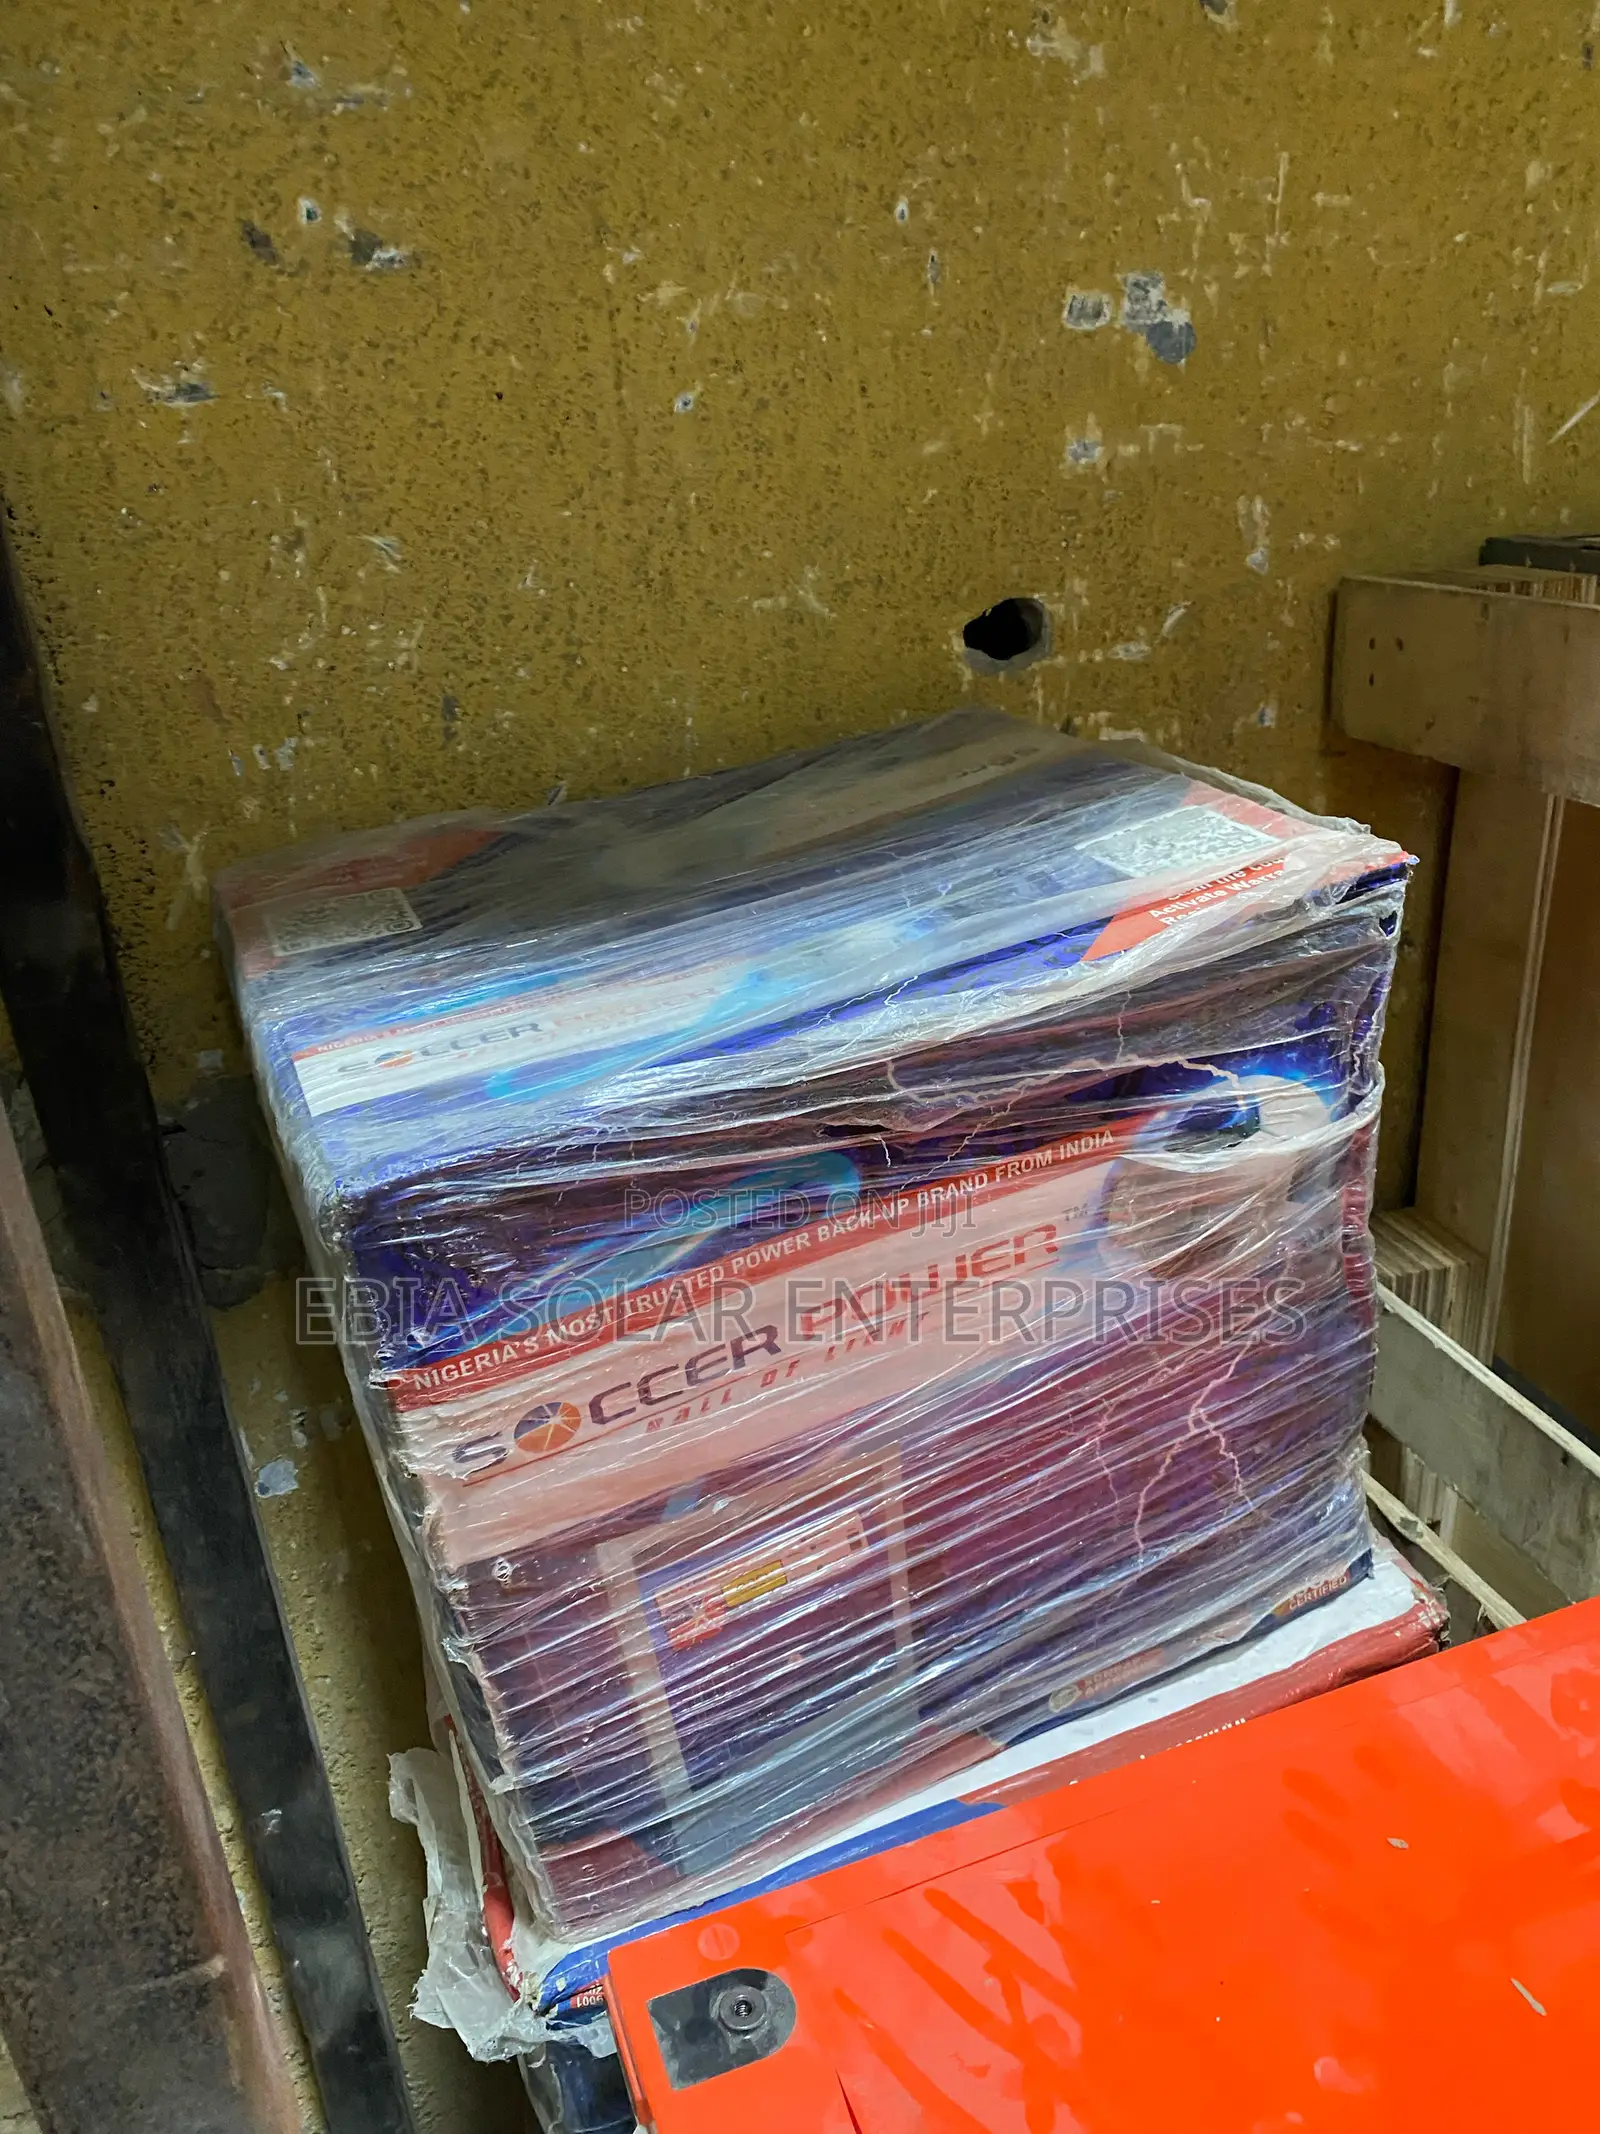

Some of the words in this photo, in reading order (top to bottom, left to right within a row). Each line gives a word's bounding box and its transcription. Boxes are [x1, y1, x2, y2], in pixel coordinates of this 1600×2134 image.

[1149, 889, 1229, 918] Activate
[1226, 869, 1285, 891] Warra
[413, 1333, 540, 1391] NIGERIA'S
[547, 1304, 615, 1346] MOST
[622, 1265, 725, 1313] TRUSTED
[731, 1232, 812, 1274] POWER
[817, 1197, 910, 1243] BACK-UP
[916, 1170, 989, 1210] BRAND
[995, 1148, 1053, 1183] FROM
[1059, 1129, 1116, 1162] INDIA
[1288, 1574, 1347, 1611] CERTIFIED
